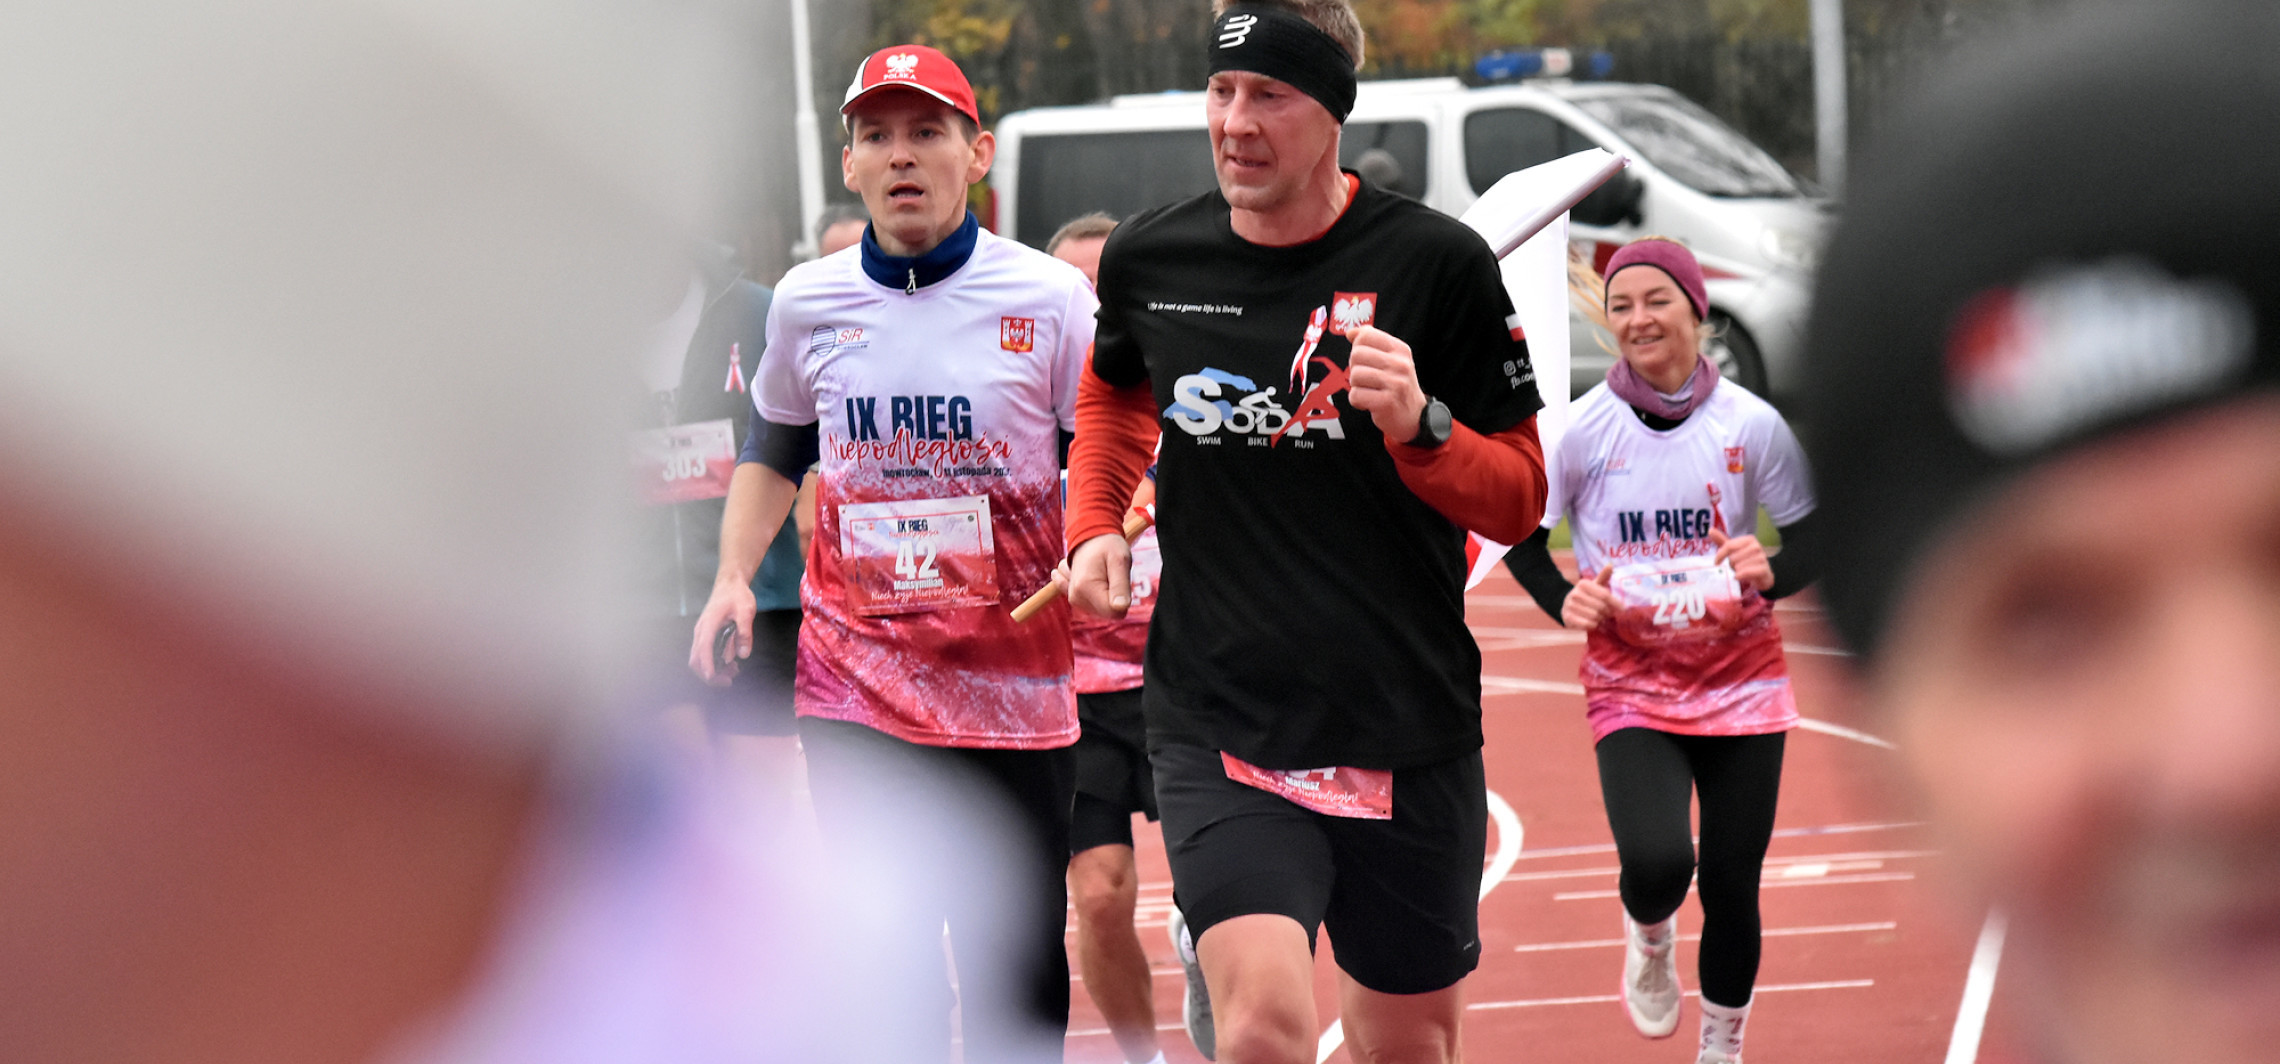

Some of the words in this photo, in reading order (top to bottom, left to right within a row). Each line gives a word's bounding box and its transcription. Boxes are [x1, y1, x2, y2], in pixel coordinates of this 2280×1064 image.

[883, 72, 917, 80] POLSKA
[1164, 303, 1176, 311] not
[1181, 303, 1202, 313] game
[1203, 304, 1214, 314] life
[1222, 305, 1243, 316] living
[846, 397, 880, 441] IX
[891, 396, 972, 441] BIEG
[828, 427, 1012, 479] Niepodległości
[1197, 437, 1221, 446] SWIM
[1247, 437, 1268, 447] BIKE
[1294, 440, 1314, 449] RUN
[662, 448, 706, 482] 303
[898, 519, 906, 533] IX
[908, 518, 928, 532] BIEG
[1619, 511, 1646, 542] IX
[1655, 508, 1710, 540] BIEG
[895, 540, 940, 580] 42
[894, 578, 944, 591] Maksymilian
[1652, 588, 1706, 625] 220
[1285, 776, 1320, 791] Mariusz
